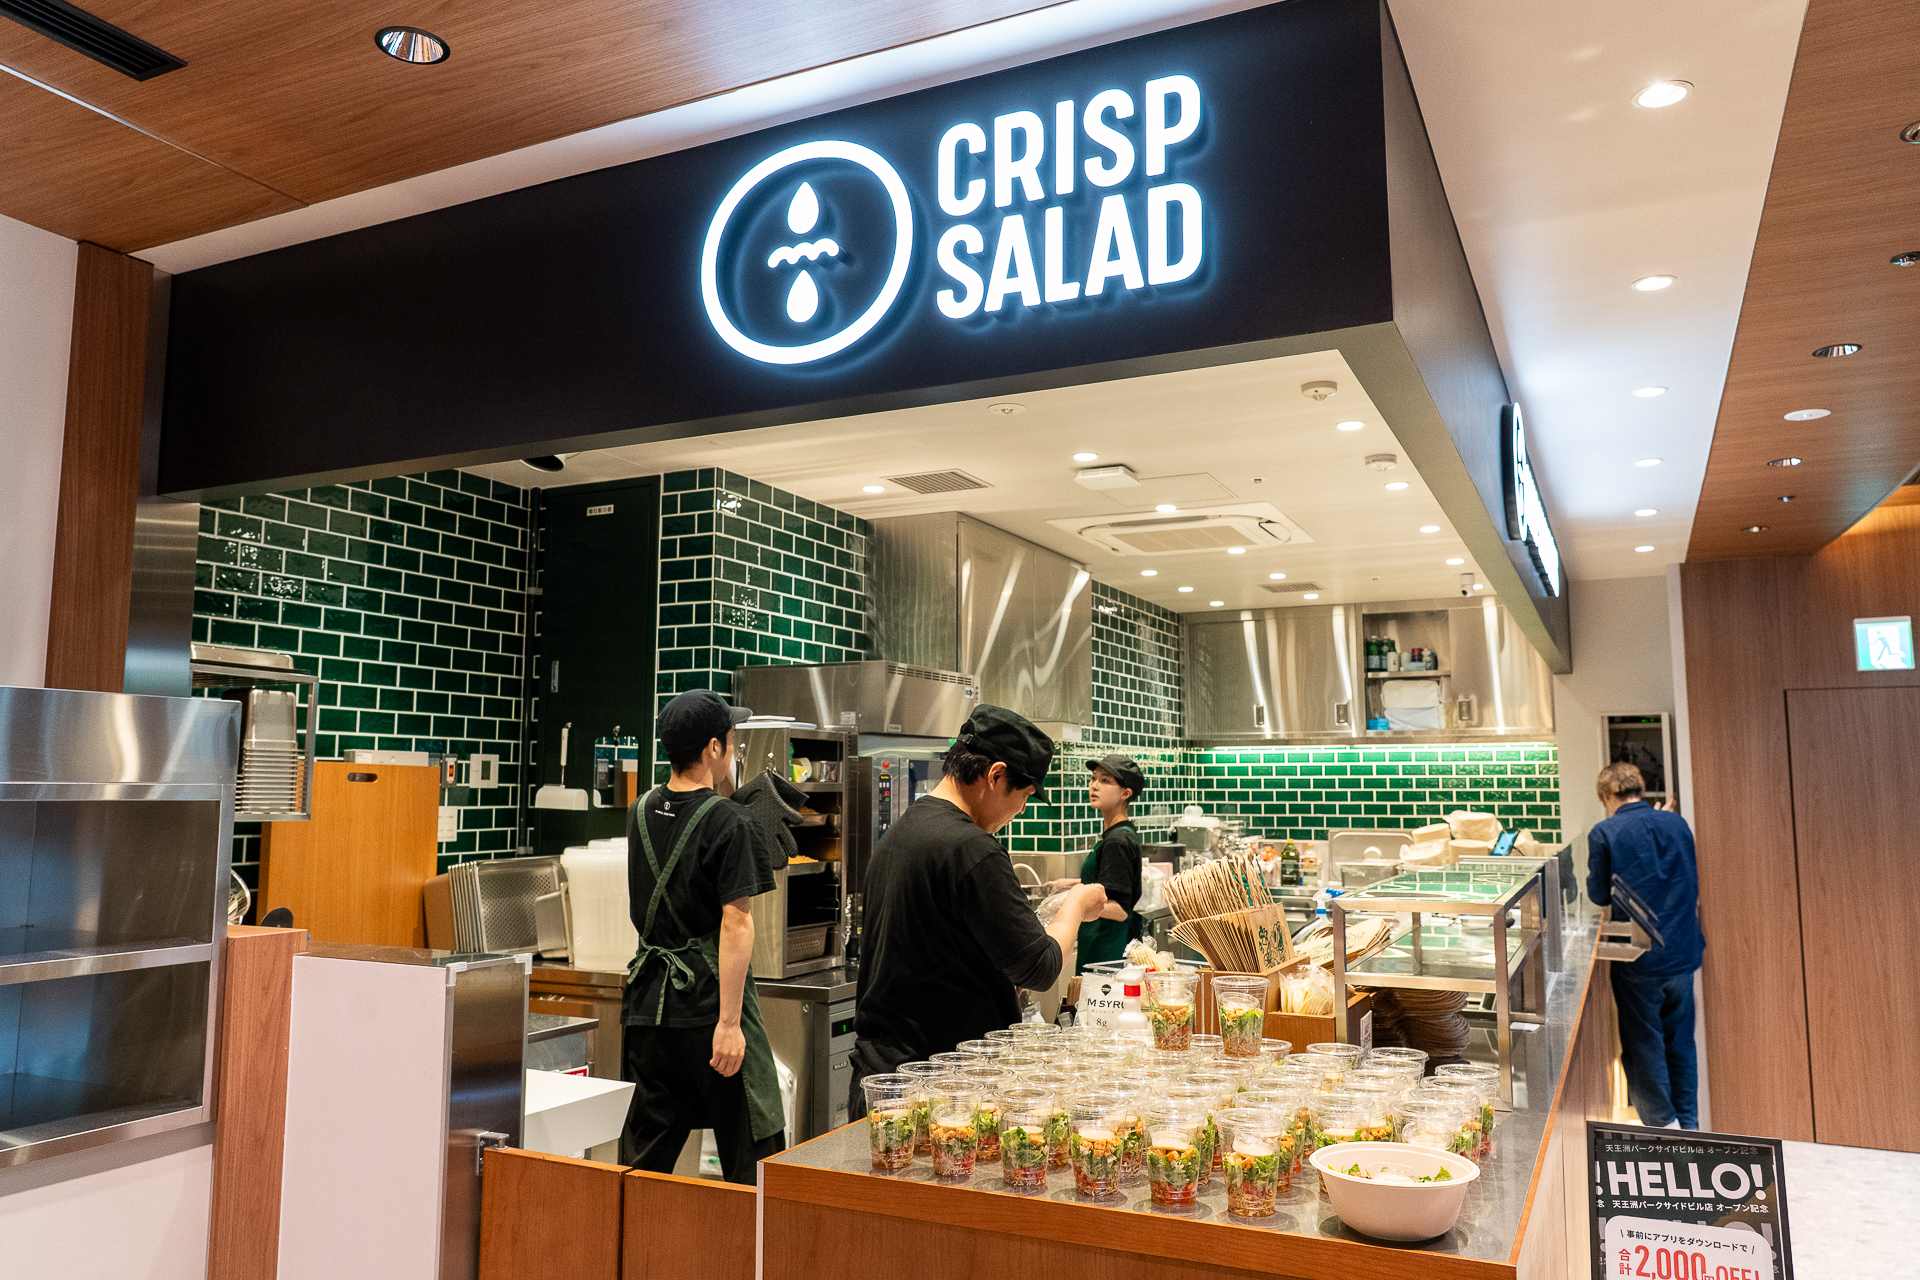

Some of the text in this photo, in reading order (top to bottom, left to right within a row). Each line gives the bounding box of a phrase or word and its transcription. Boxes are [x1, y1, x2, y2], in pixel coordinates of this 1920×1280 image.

[937, 74, 1201, 217] CRISP
[936, 182, 1203, 319] SALAD
[1096, 1018, 1108, 1028] 8g
[1605, 1144, 1759, 1155] 天王洲パークサイドビル店 オープン記念
[1607, 1161, 1767, 1200] HELLO!
[1612, 1200, 1714, 1212] 天王洲パークサイドビル店
[1716, 1203, 1769, 1213] オープン記念
[1626, 1229, 1748, 1253] 事前にアプリをダウンロードで
[1618, 1248, 1632, 1276] 合計
